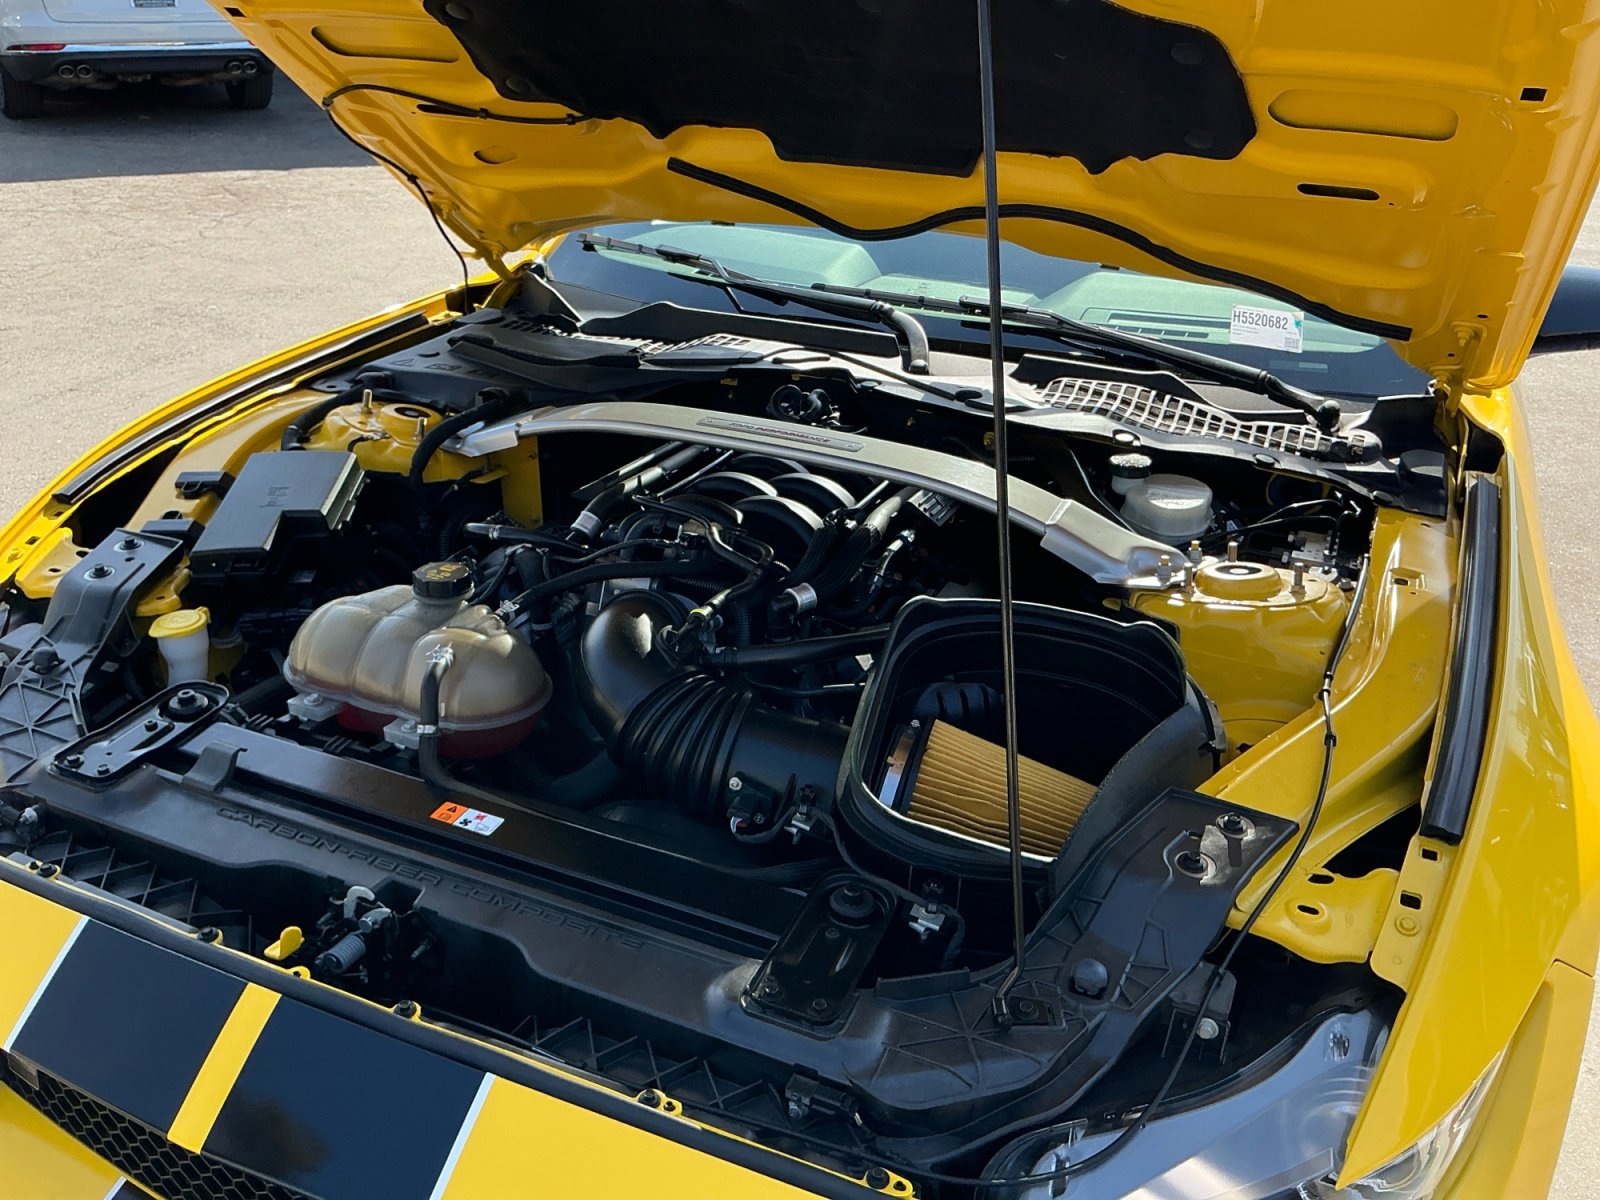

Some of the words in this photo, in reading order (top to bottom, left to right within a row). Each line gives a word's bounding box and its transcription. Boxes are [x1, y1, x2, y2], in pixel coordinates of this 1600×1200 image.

[1233, 310, 1289, 330] H5520682
[216, 806, 443, 887] CARBON-FIBER
[449, 882, 646, 951] COMPOSITE
